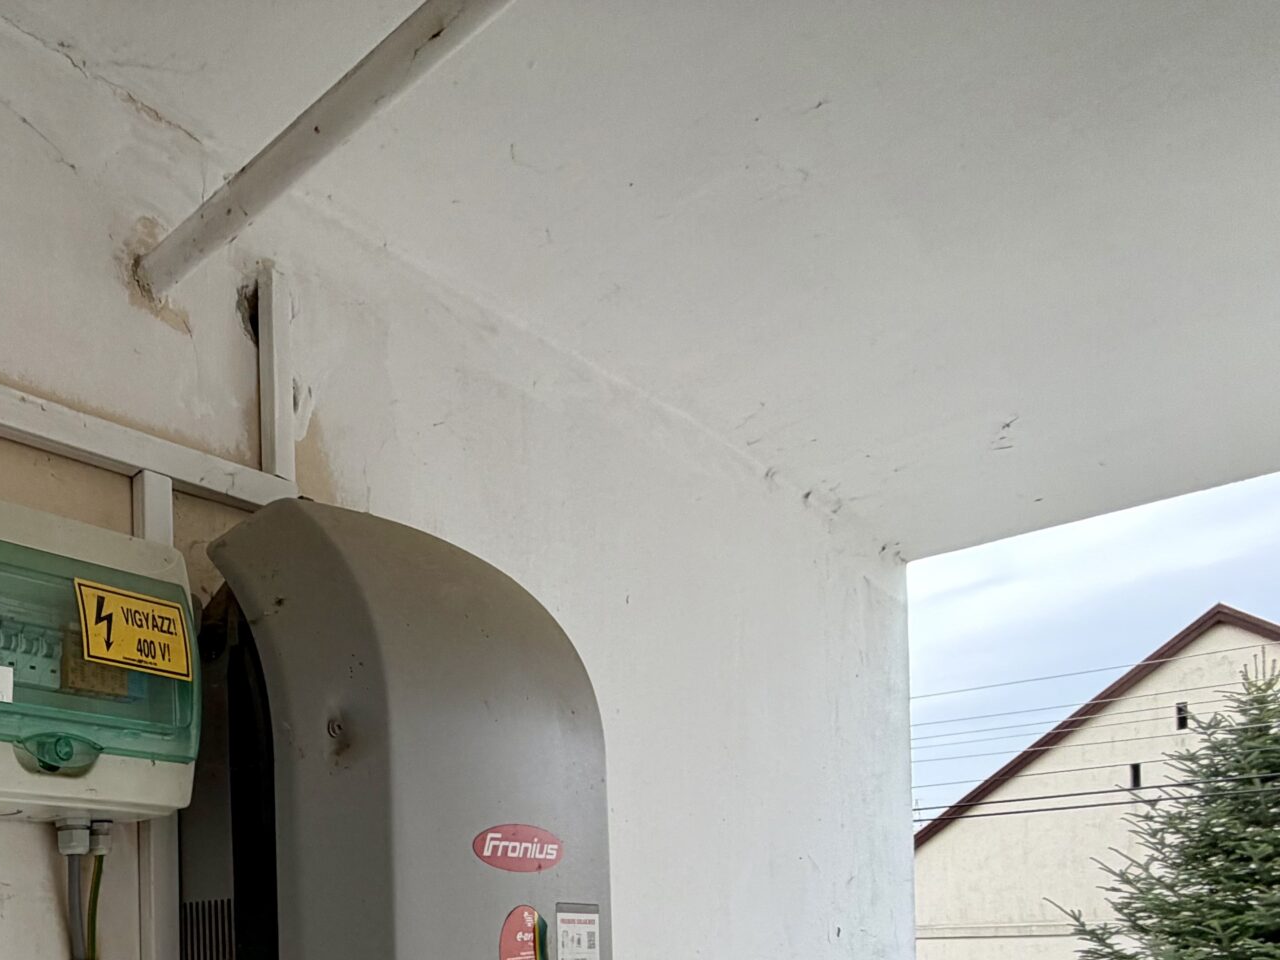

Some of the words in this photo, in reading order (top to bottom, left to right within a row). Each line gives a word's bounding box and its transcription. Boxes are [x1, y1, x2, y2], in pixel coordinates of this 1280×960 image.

[120, 605, 178, 636] VIGYÁZZ!
[136, 638, 156, 660] 400
[158, 641, 171, 663] V!
[483, 832, 559, 860] Fronius
